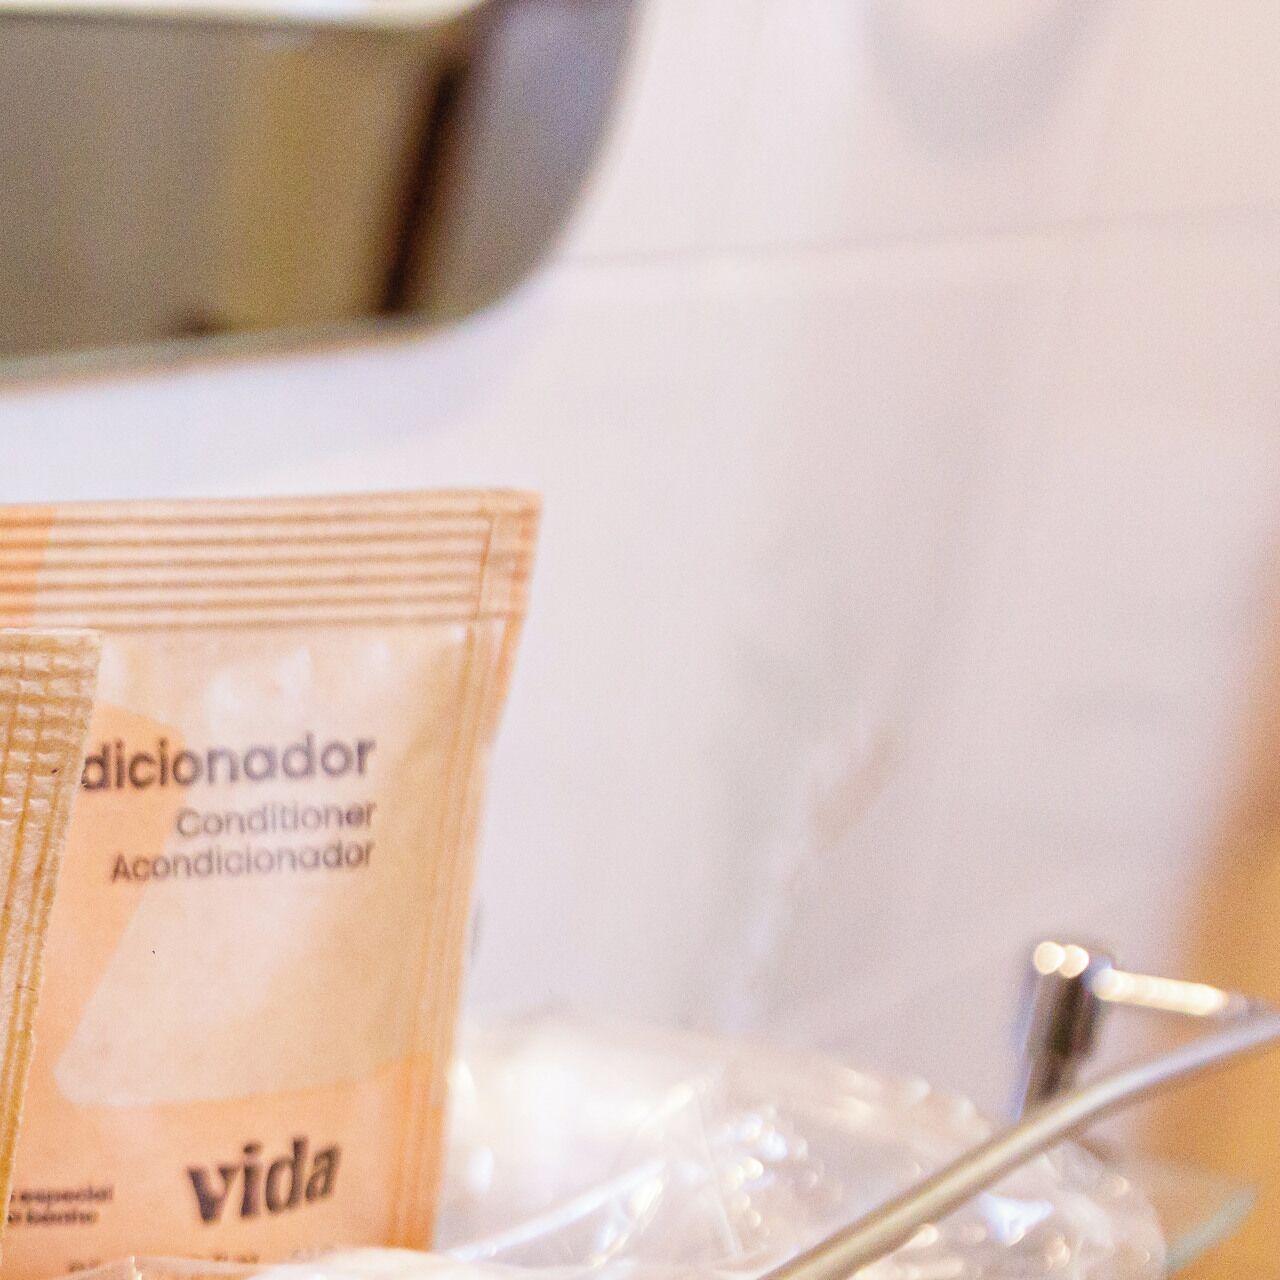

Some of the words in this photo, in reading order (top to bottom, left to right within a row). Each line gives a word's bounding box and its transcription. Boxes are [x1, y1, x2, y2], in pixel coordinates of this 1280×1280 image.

[81, 732, 376, 790] dicionador
[176, 800, 377, 838] Conditioner
[110, 843, 374, 883] Acondicionador
[186, 1135, 341, 1224] vida
